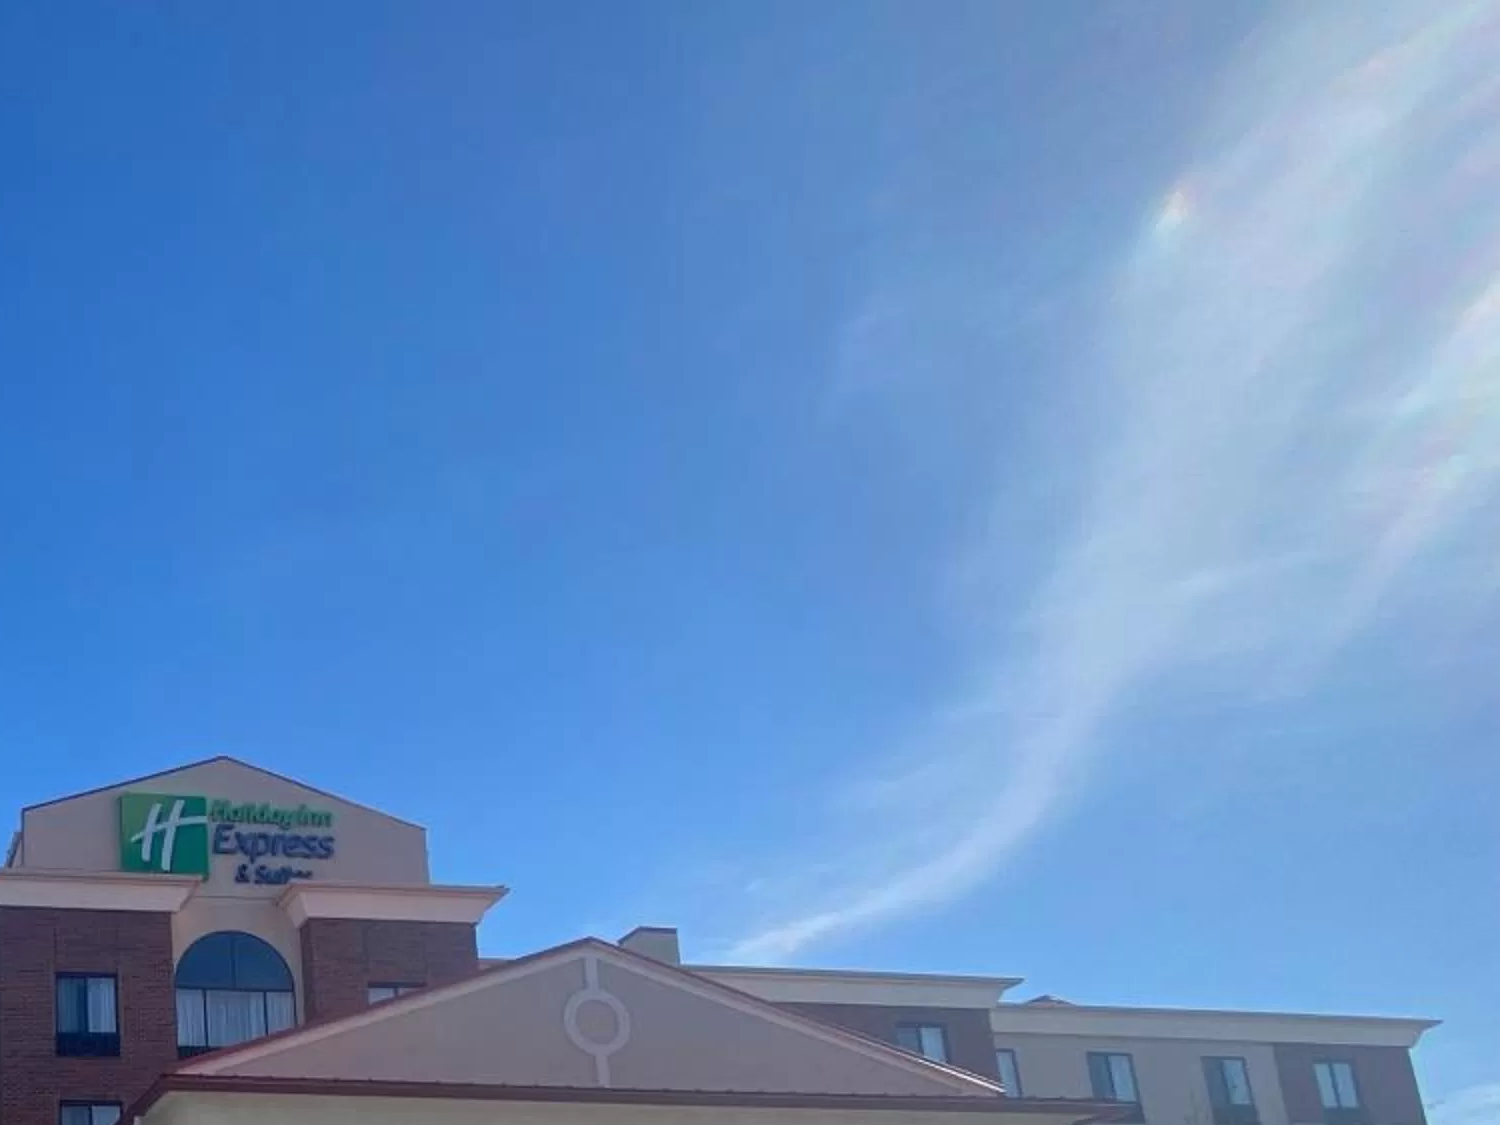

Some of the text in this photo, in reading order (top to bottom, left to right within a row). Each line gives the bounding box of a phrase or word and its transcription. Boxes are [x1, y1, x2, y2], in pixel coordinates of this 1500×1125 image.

[209, 800, 333, 830] Holiday Inn
[212, 823, 334, 863] Express
[235, 863, 250, 883] &
